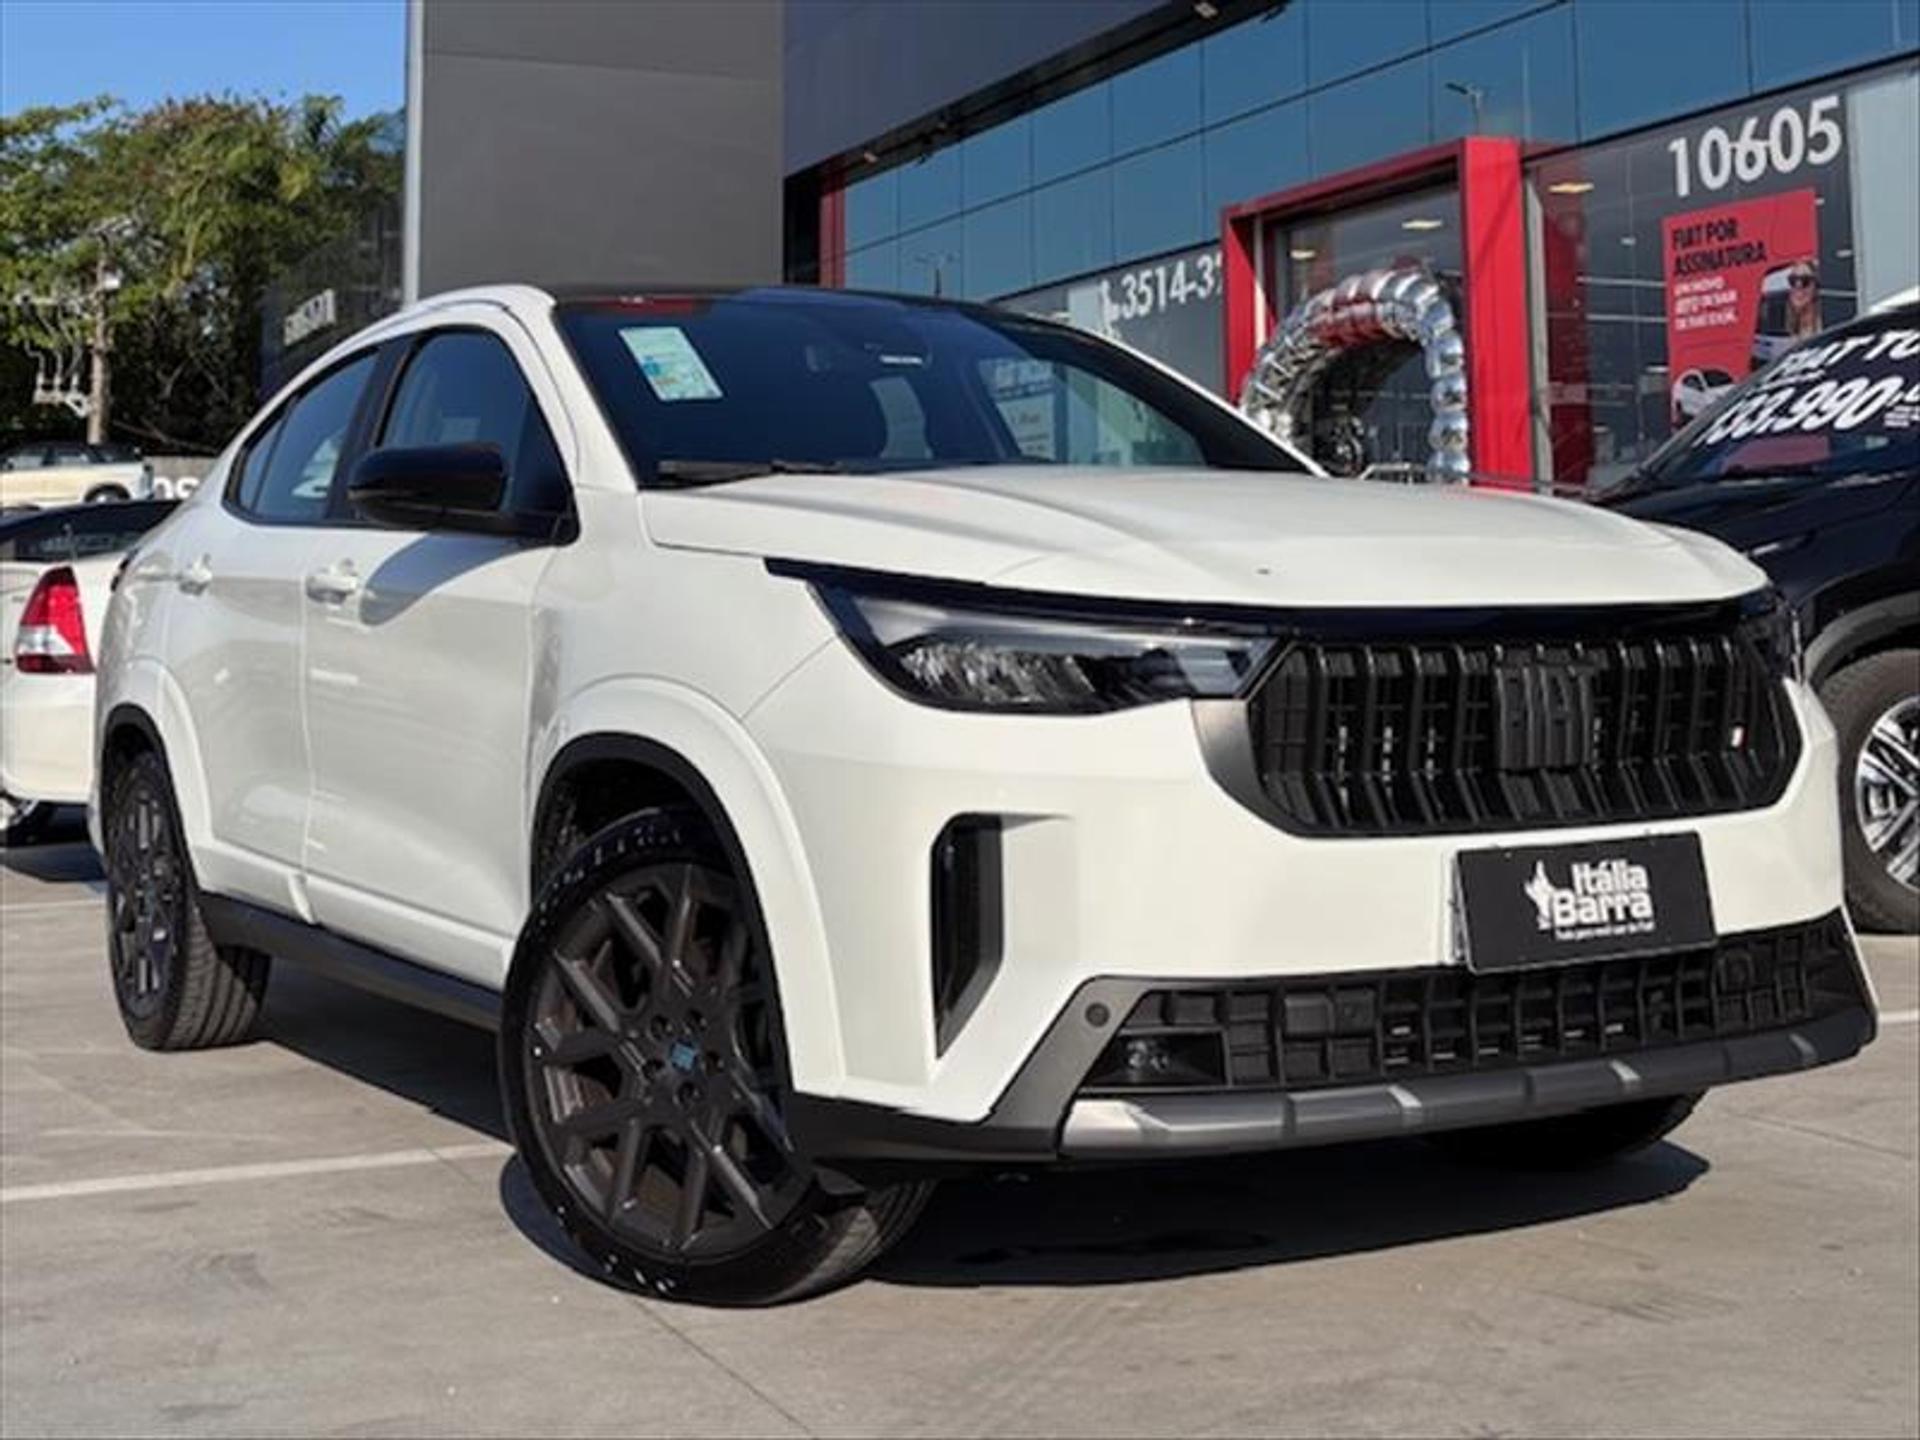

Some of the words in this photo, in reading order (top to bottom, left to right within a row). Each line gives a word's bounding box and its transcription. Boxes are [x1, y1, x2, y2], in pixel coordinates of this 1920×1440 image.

[1668, 95, 1842, 197] 10605
[1673, 224, 1702, 250] FIAT
[1706, 218, 1738, 243] POR
[1674, 241, 1767, 276] ASSINATURA
[1571, 858, 1649, 896] Itália
[1552, 887, 1655, 927] Barra
